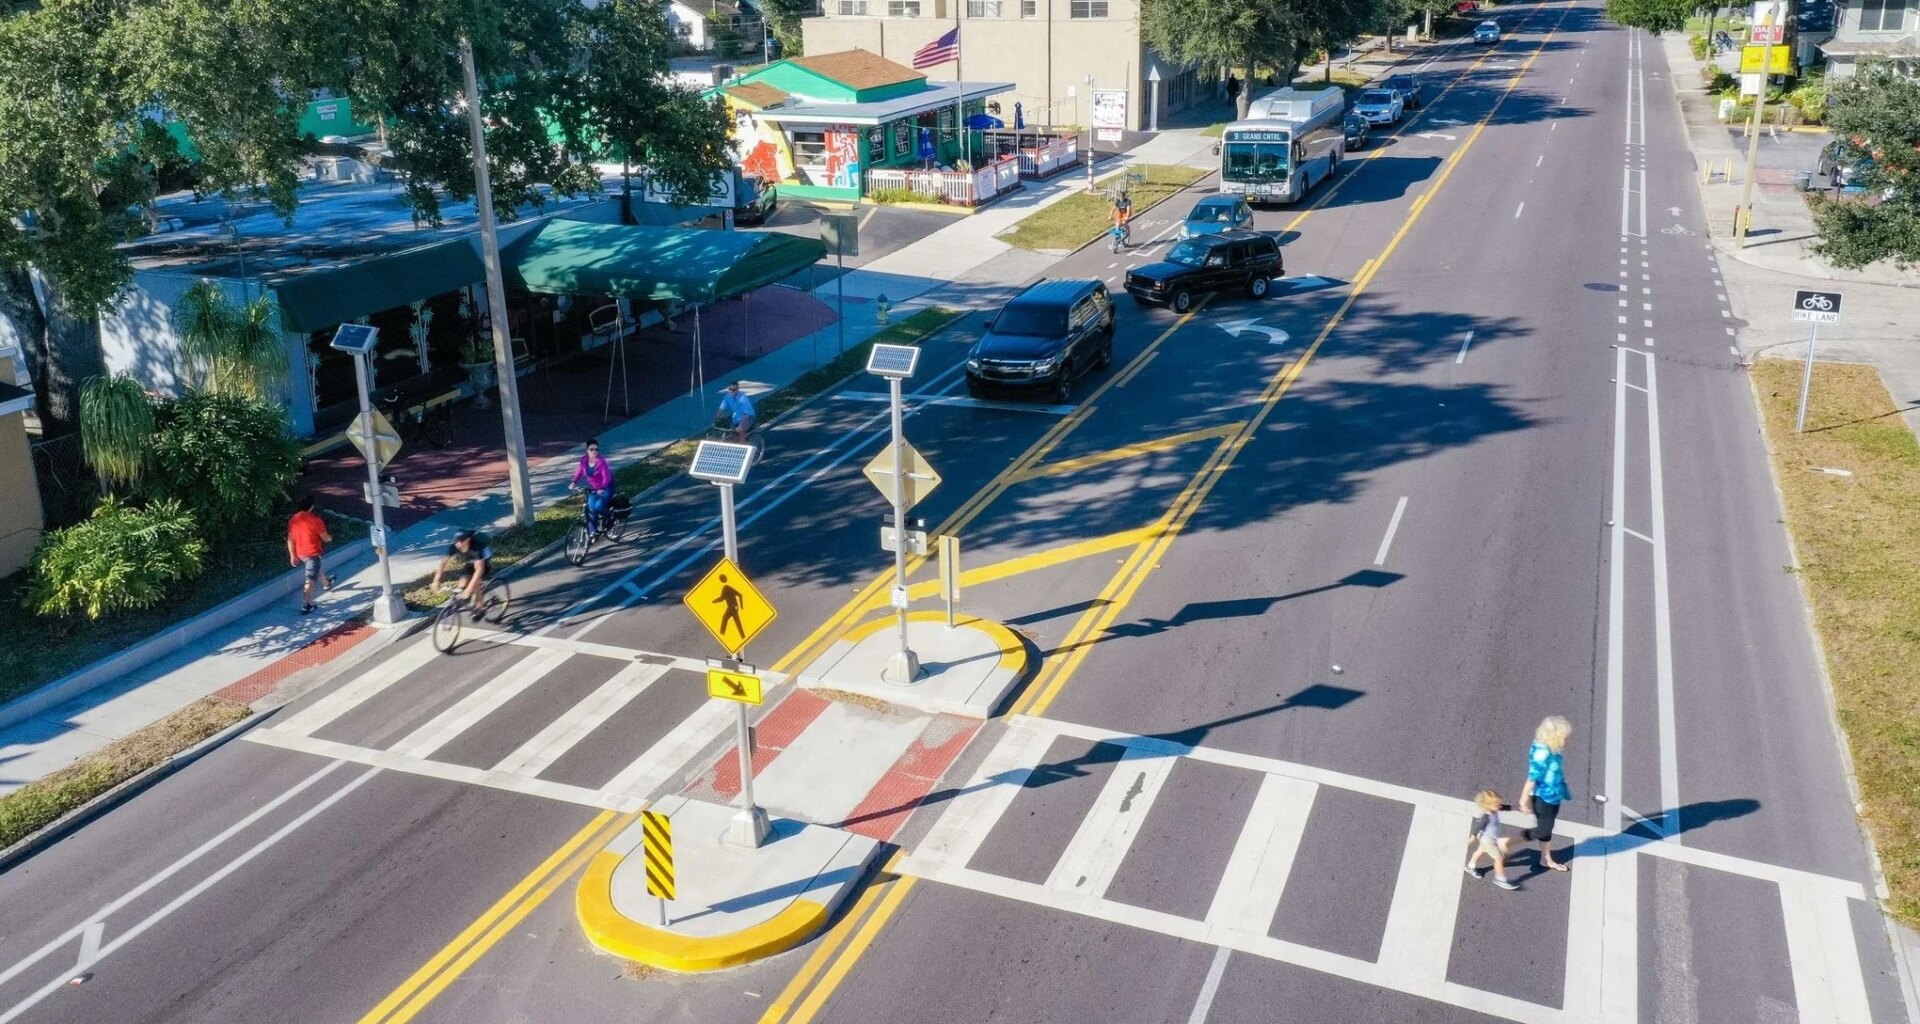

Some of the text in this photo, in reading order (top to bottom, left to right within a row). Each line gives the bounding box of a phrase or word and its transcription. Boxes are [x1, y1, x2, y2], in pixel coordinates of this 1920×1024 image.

[1754, 26, 1780, 34] DAY
[1794, 310, 1837, 322] BIKE LANE
